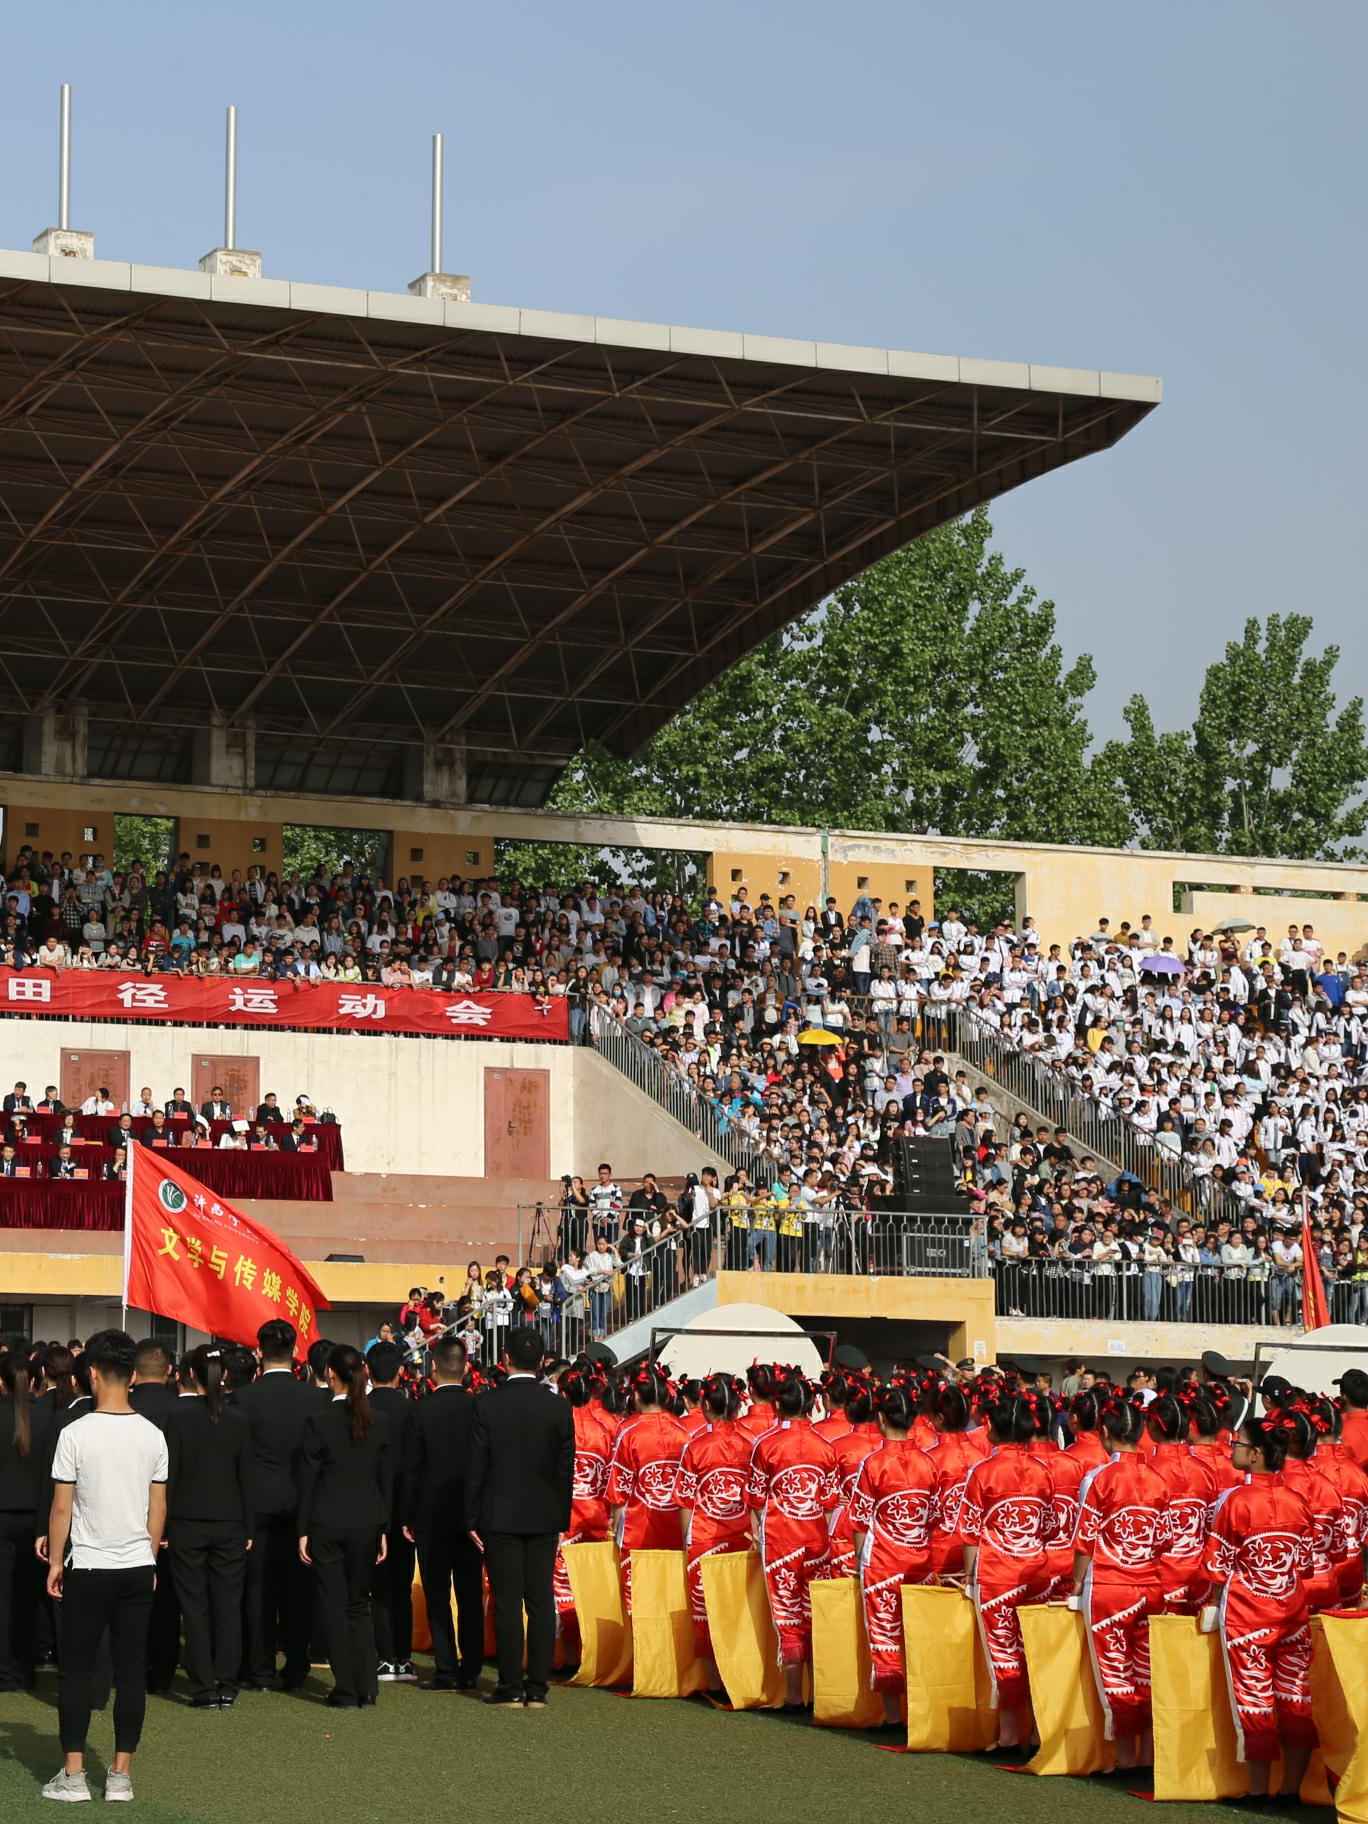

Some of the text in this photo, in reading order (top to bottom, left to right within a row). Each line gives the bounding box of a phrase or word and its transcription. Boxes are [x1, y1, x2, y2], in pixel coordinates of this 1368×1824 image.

[158, 1227, 311, 1339] 文学与传媒学院
